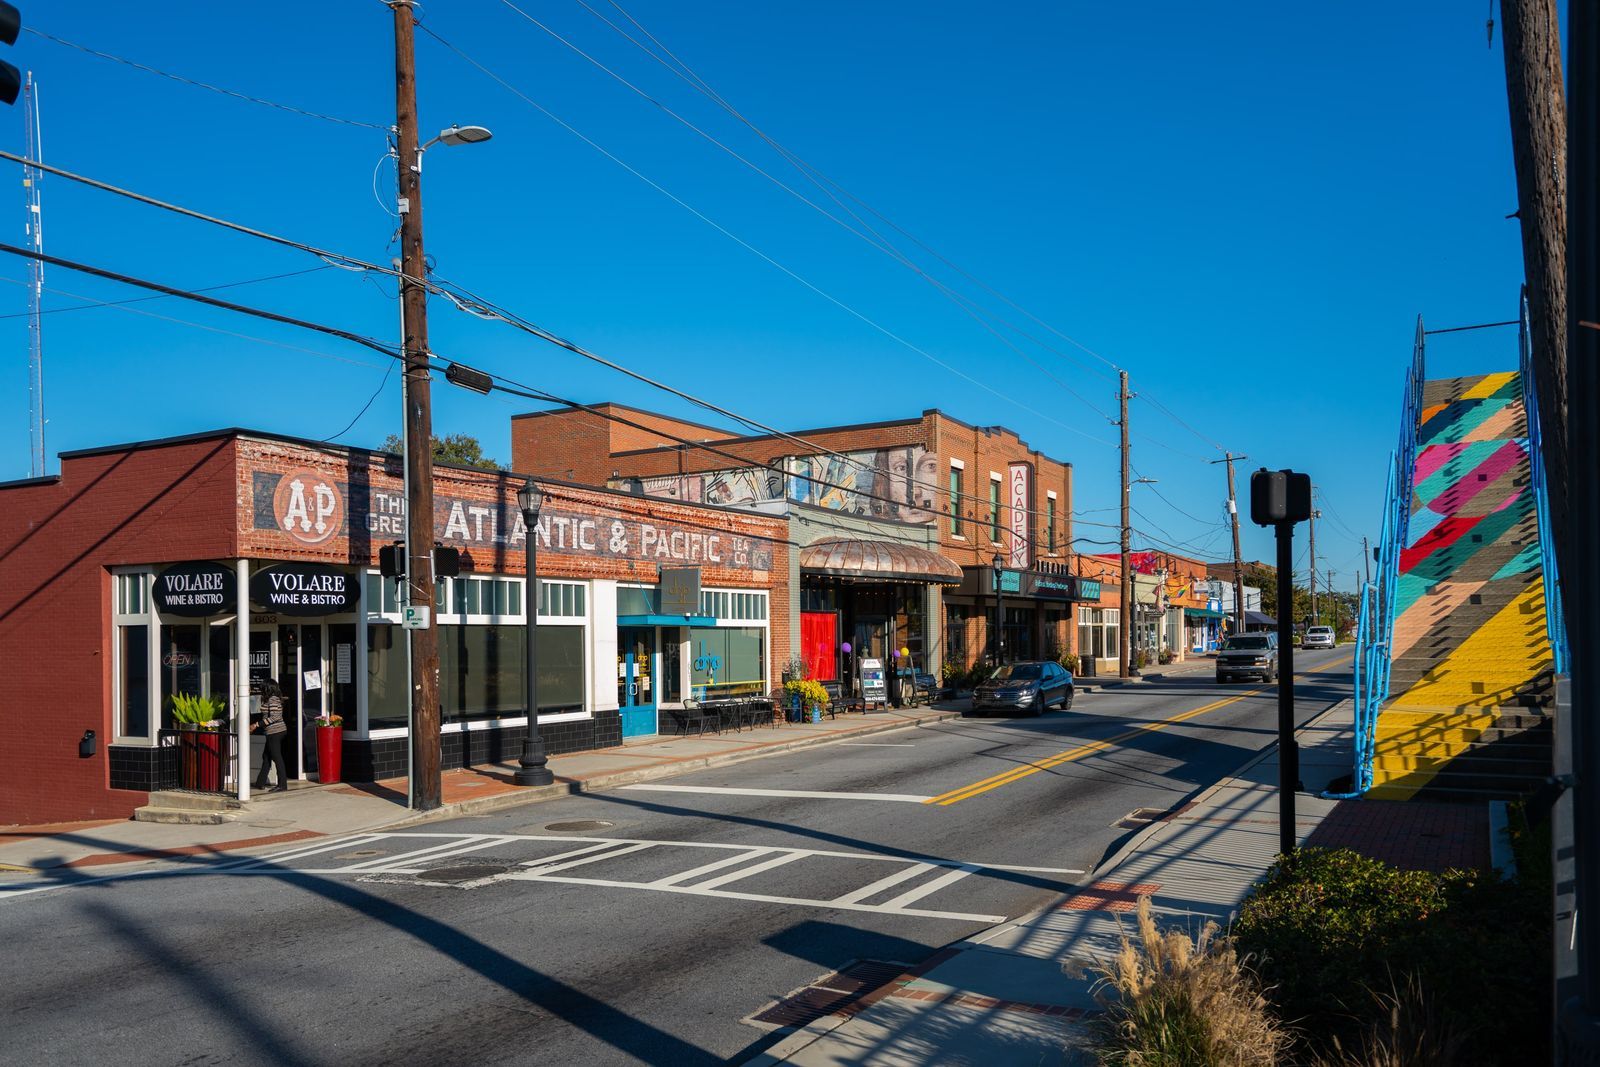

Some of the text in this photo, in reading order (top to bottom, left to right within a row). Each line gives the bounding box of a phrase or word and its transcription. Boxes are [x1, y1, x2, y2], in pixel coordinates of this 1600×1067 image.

[283, 479, 336, 534] A&P
[1014, 469, 1025, 562] ACADEMY
[443, 501, 596, 551] ATLANTIC
[609, 520, 628, 554] &
[641, 524, 721, 562] PACIFIC
[731, 537, 749, 551] TEA
[734, 551, 749, 565] CO.
[165, 573, 223, 592] VOLARE
[269, 573, 345, 592] VOLARE
[165, 593, 223, 605] WINE & BISTRO
[270, 593, 345, 604] WINE & BISTRO
